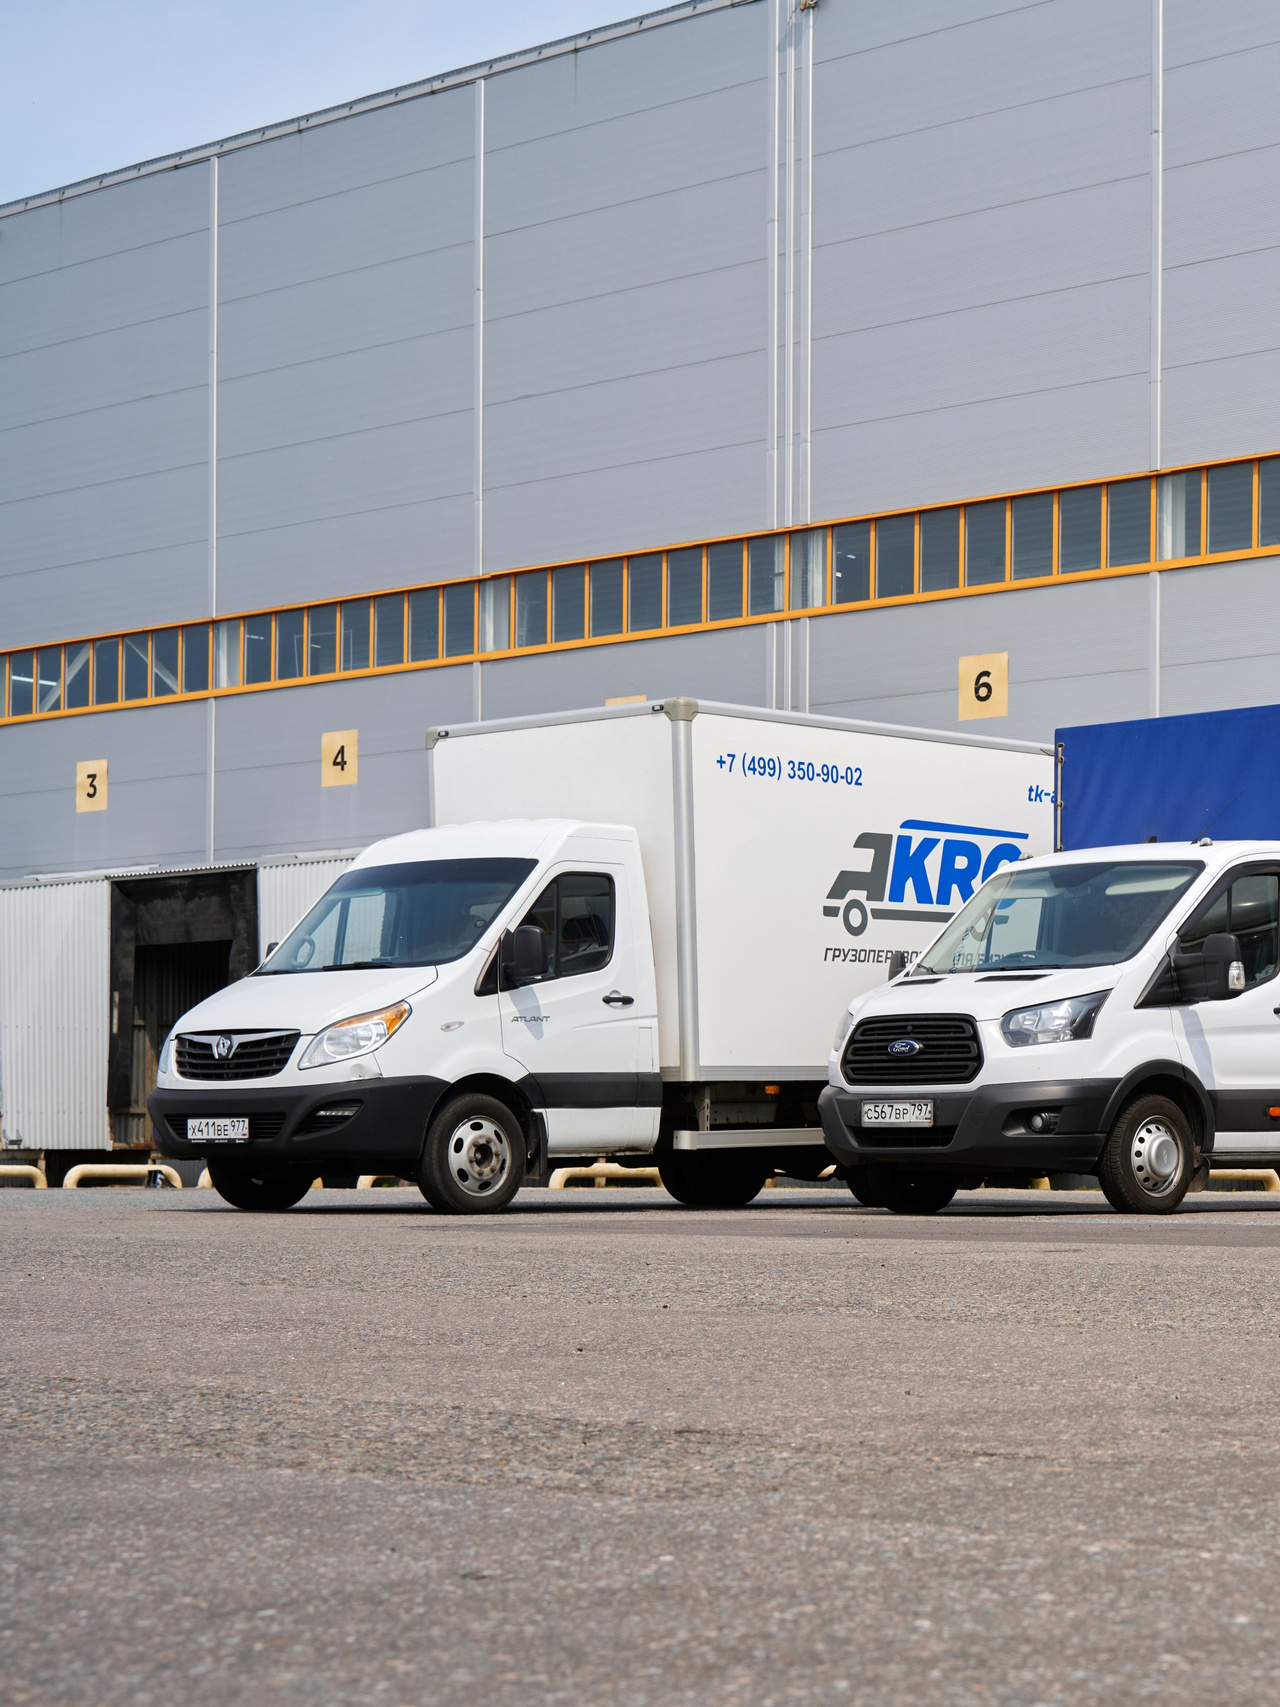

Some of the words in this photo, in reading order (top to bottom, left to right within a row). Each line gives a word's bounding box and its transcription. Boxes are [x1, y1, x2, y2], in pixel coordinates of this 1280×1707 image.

[973, 669, 993, 703] 6
[331, 745, 348, 772] 4
[716, 753, 737, 773] +7
[741, 752, 782, 781] (499)
[787, 759, 864, 787] 350-90-02
[86, 773, 98, 799] 3
[510, 1015, 551, 1023] ATLANT
[911, 1103, 929, 1116] 797
[230, 1119, 246, 1132] 977
